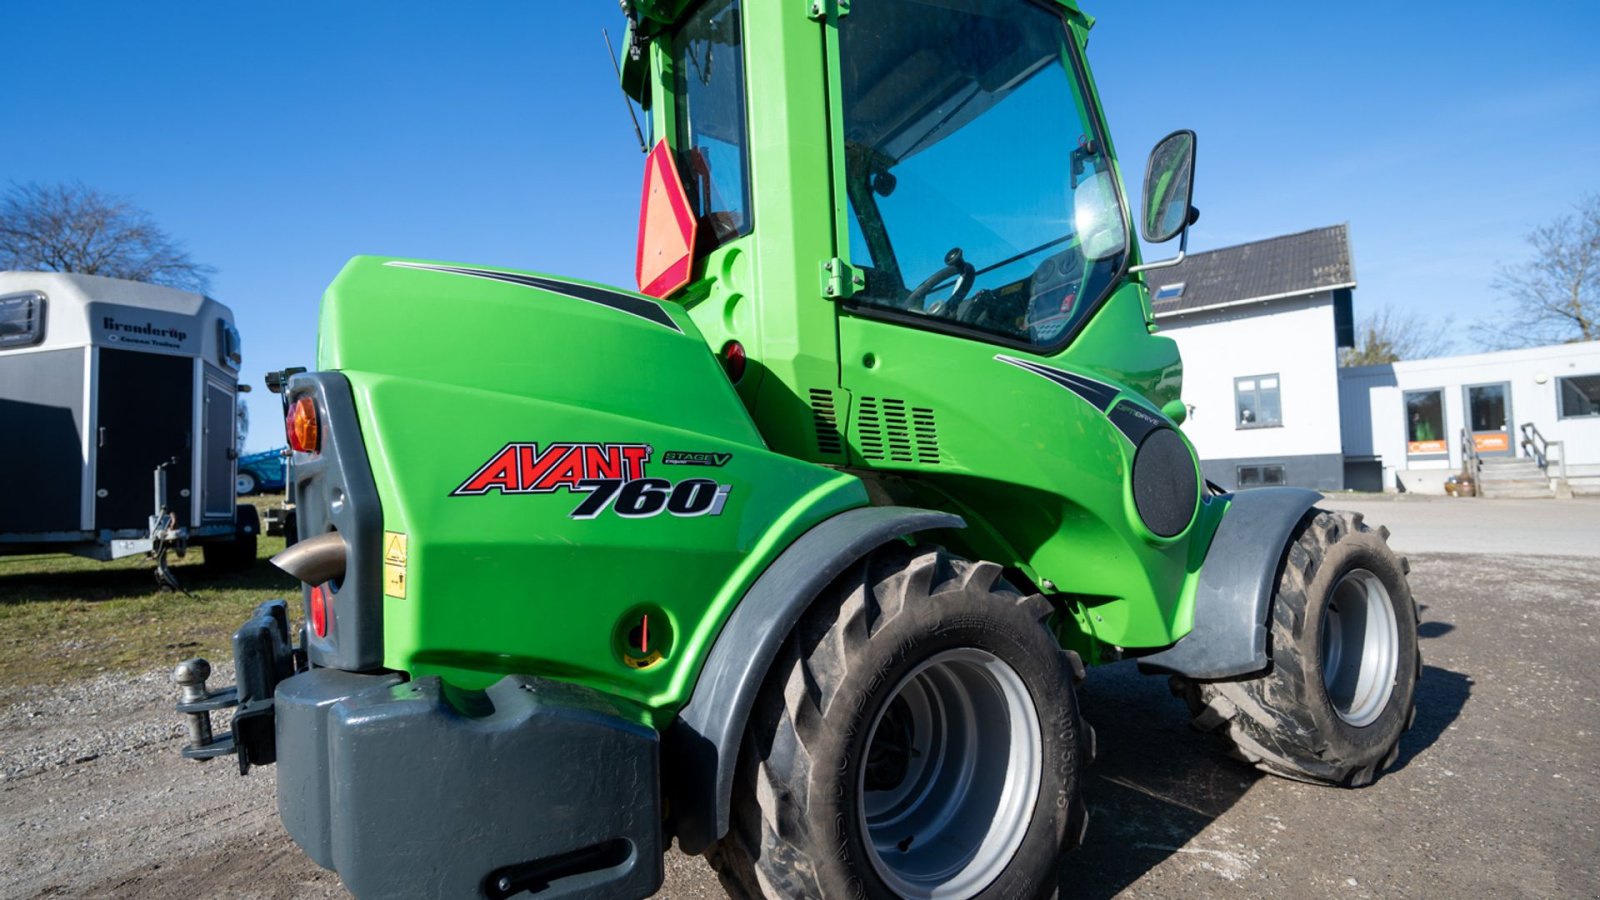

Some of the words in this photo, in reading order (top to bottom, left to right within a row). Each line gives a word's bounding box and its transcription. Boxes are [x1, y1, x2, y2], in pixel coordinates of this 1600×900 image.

[448, 441, 651, 497] AVANT
[665, 452, 713, 461] STAGE
[713, 453, 731, 465] V
[568, 478, 733, 520] 760i
